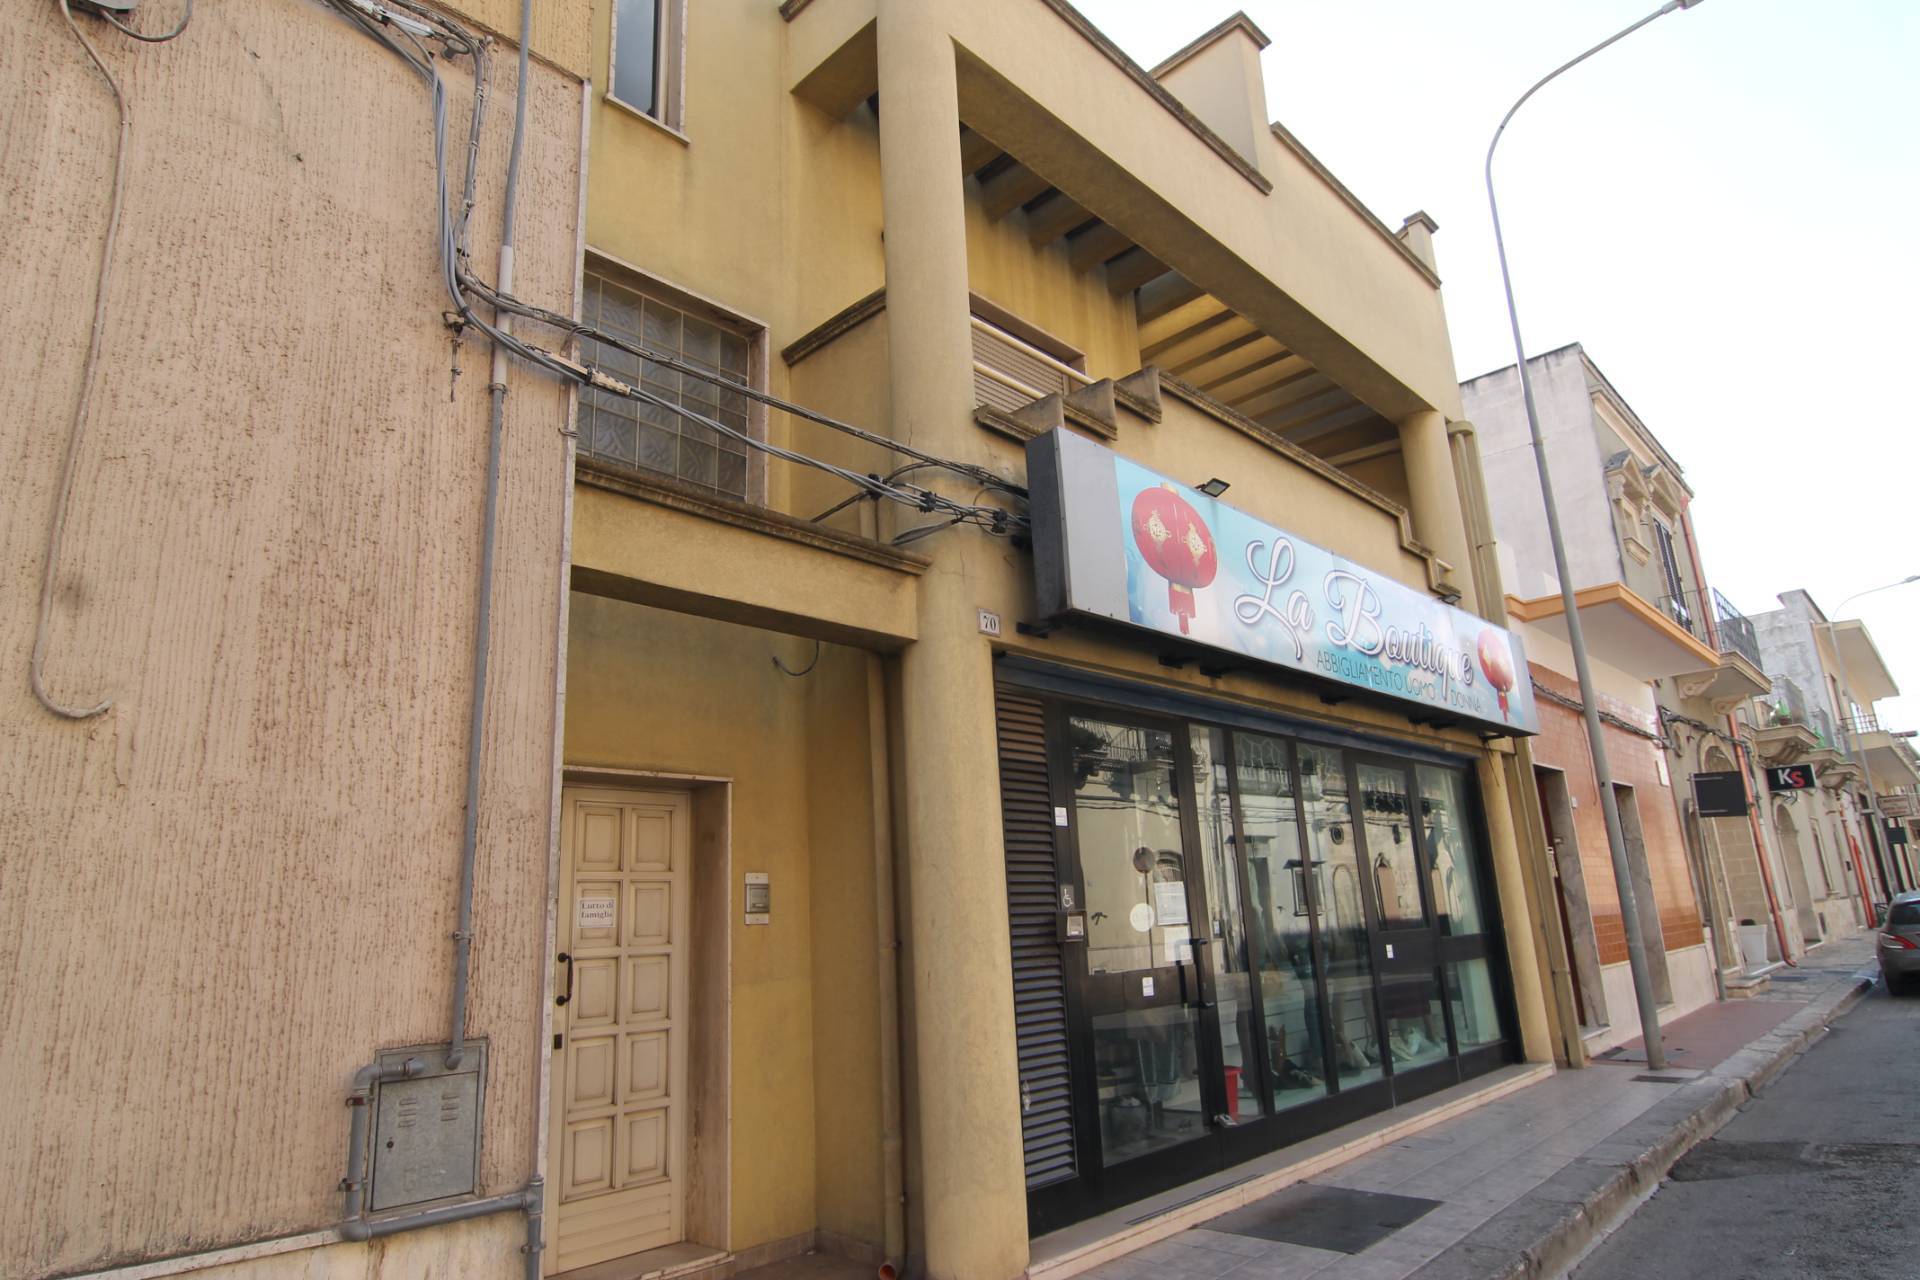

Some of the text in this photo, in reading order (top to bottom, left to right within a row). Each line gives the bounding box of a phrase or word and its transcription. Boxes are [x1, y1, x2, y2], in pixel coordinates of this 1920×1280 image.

[982, 614, 997, 631] 70
[1234, 537, 1474, 701] La Boutique
[1317, 650, 1482, 713] ABBIGLIAMENTO UOMO DONNA
[1777, 768, 1806, 789] KS
